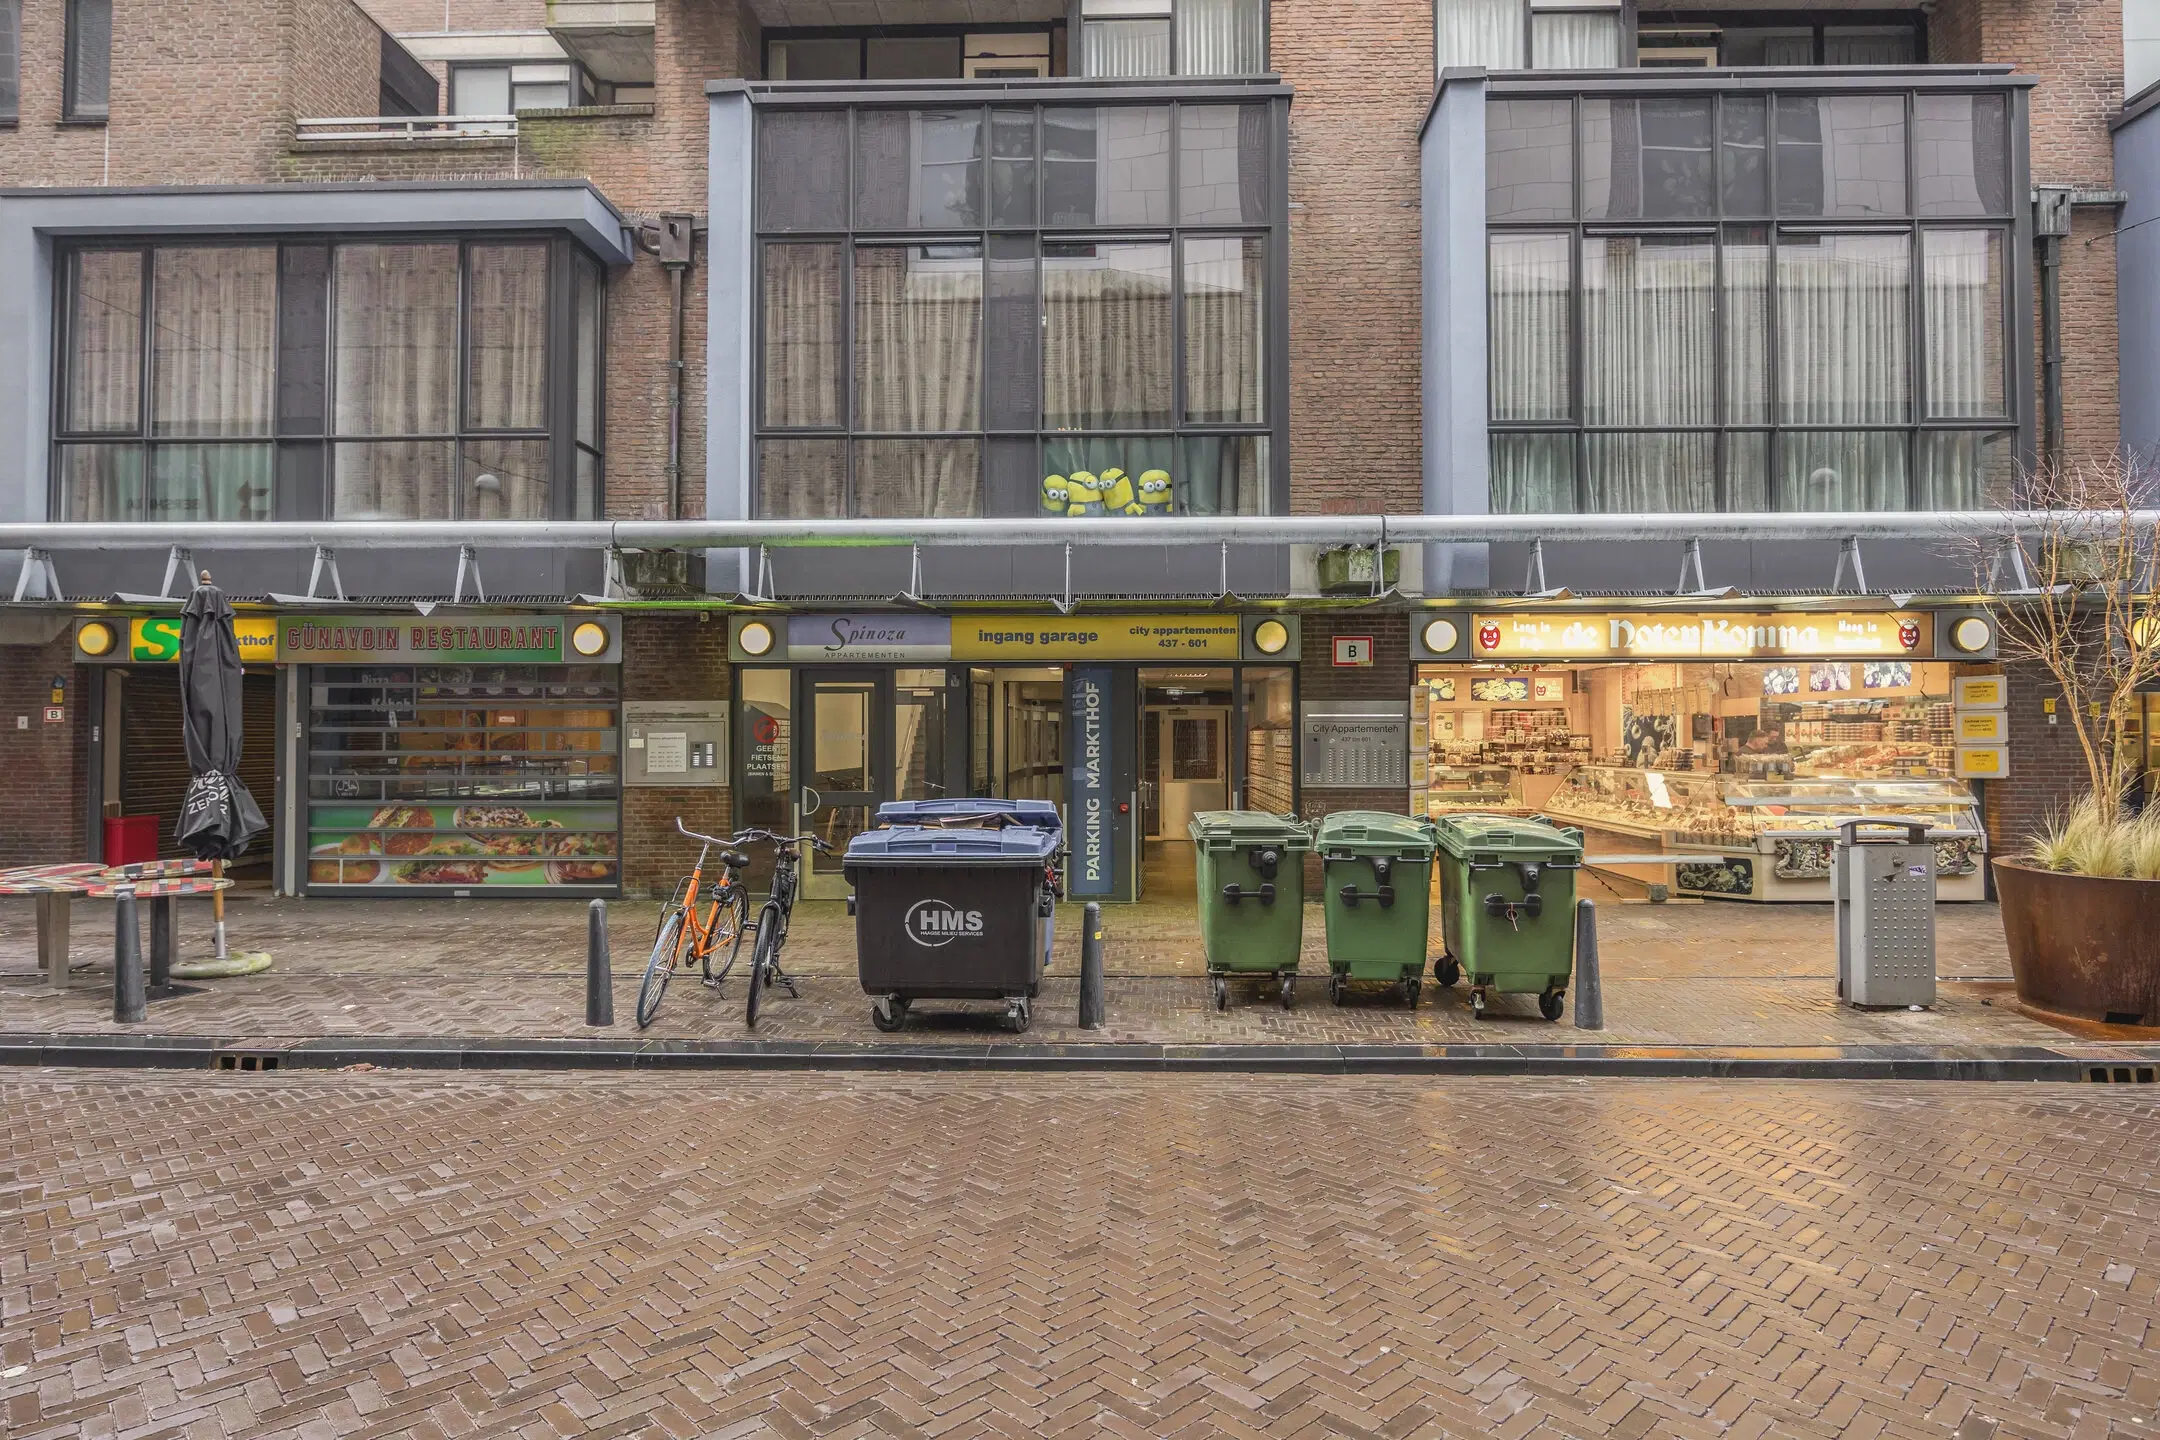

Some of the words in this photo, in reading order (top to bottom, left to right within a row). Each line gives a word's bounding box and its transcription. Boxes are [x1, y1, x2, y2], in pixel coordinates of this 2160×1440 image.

[287, 622, 400, 650] GÜNAYDIN
[410, 626, 558, 650] RESTAURANT
[824, 617, 906, 651] Spinoza
[978, 629, 1035, 644] ingang
[1039, 631, 1099, 644] garage
[1129, 625, 1150, 636] city
[1152, 626, 1236, 636] appartementen
[1158, 639, 1178, 648] 437
[1188, 639, 1208, 648] 601
[1348, 645, 1357, 657] B
[51, 710, 58, 718] B
[1086, 682, 1100, 789] MARKTHOF
[1312, 724, 1330, 734] City
[1086, 798, 1100, 881] PARKING
[920, 910, 984, 931] HMS
